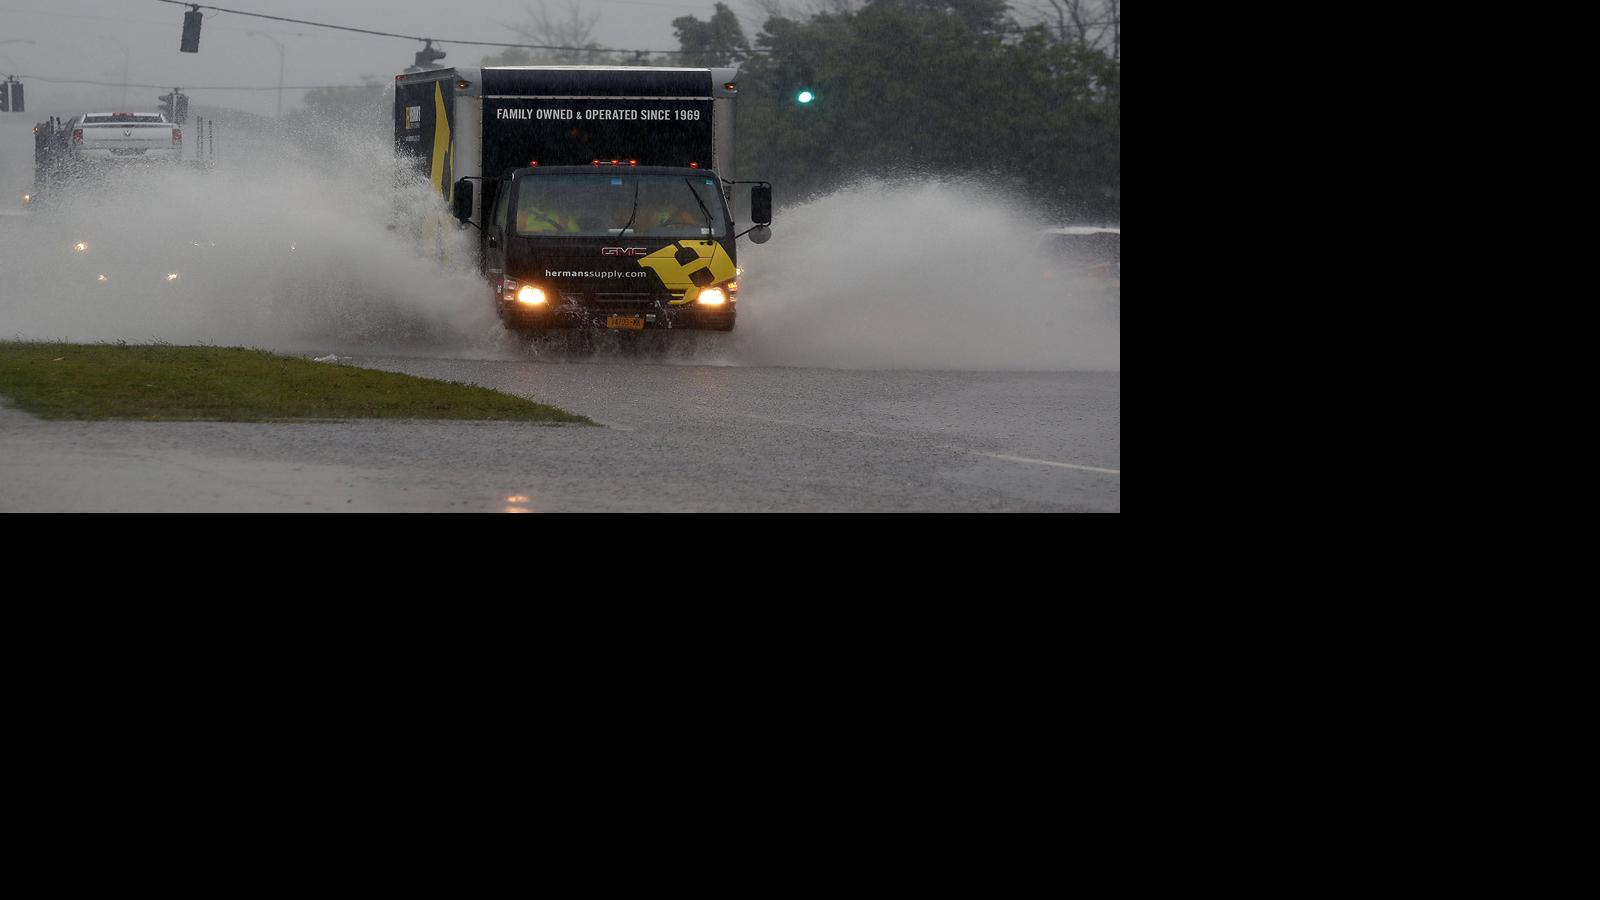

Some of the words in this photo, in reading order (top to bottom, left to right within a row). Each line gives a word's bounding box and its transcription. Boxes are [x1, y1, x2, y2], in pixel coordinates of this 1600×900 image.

[496, 108, 533, 120] FAMILY
[536, 108, 573, 120] OWNED
[575, 111, 583, 120] &
[585, 109, 638, 120] OPERATED
[640, 109, 671, 121] SINCE
[674, 109, 700, 121] 1969
[601, 246, 647, 257] GMC
[545, 269, 647, 279] hermanssupply.com
